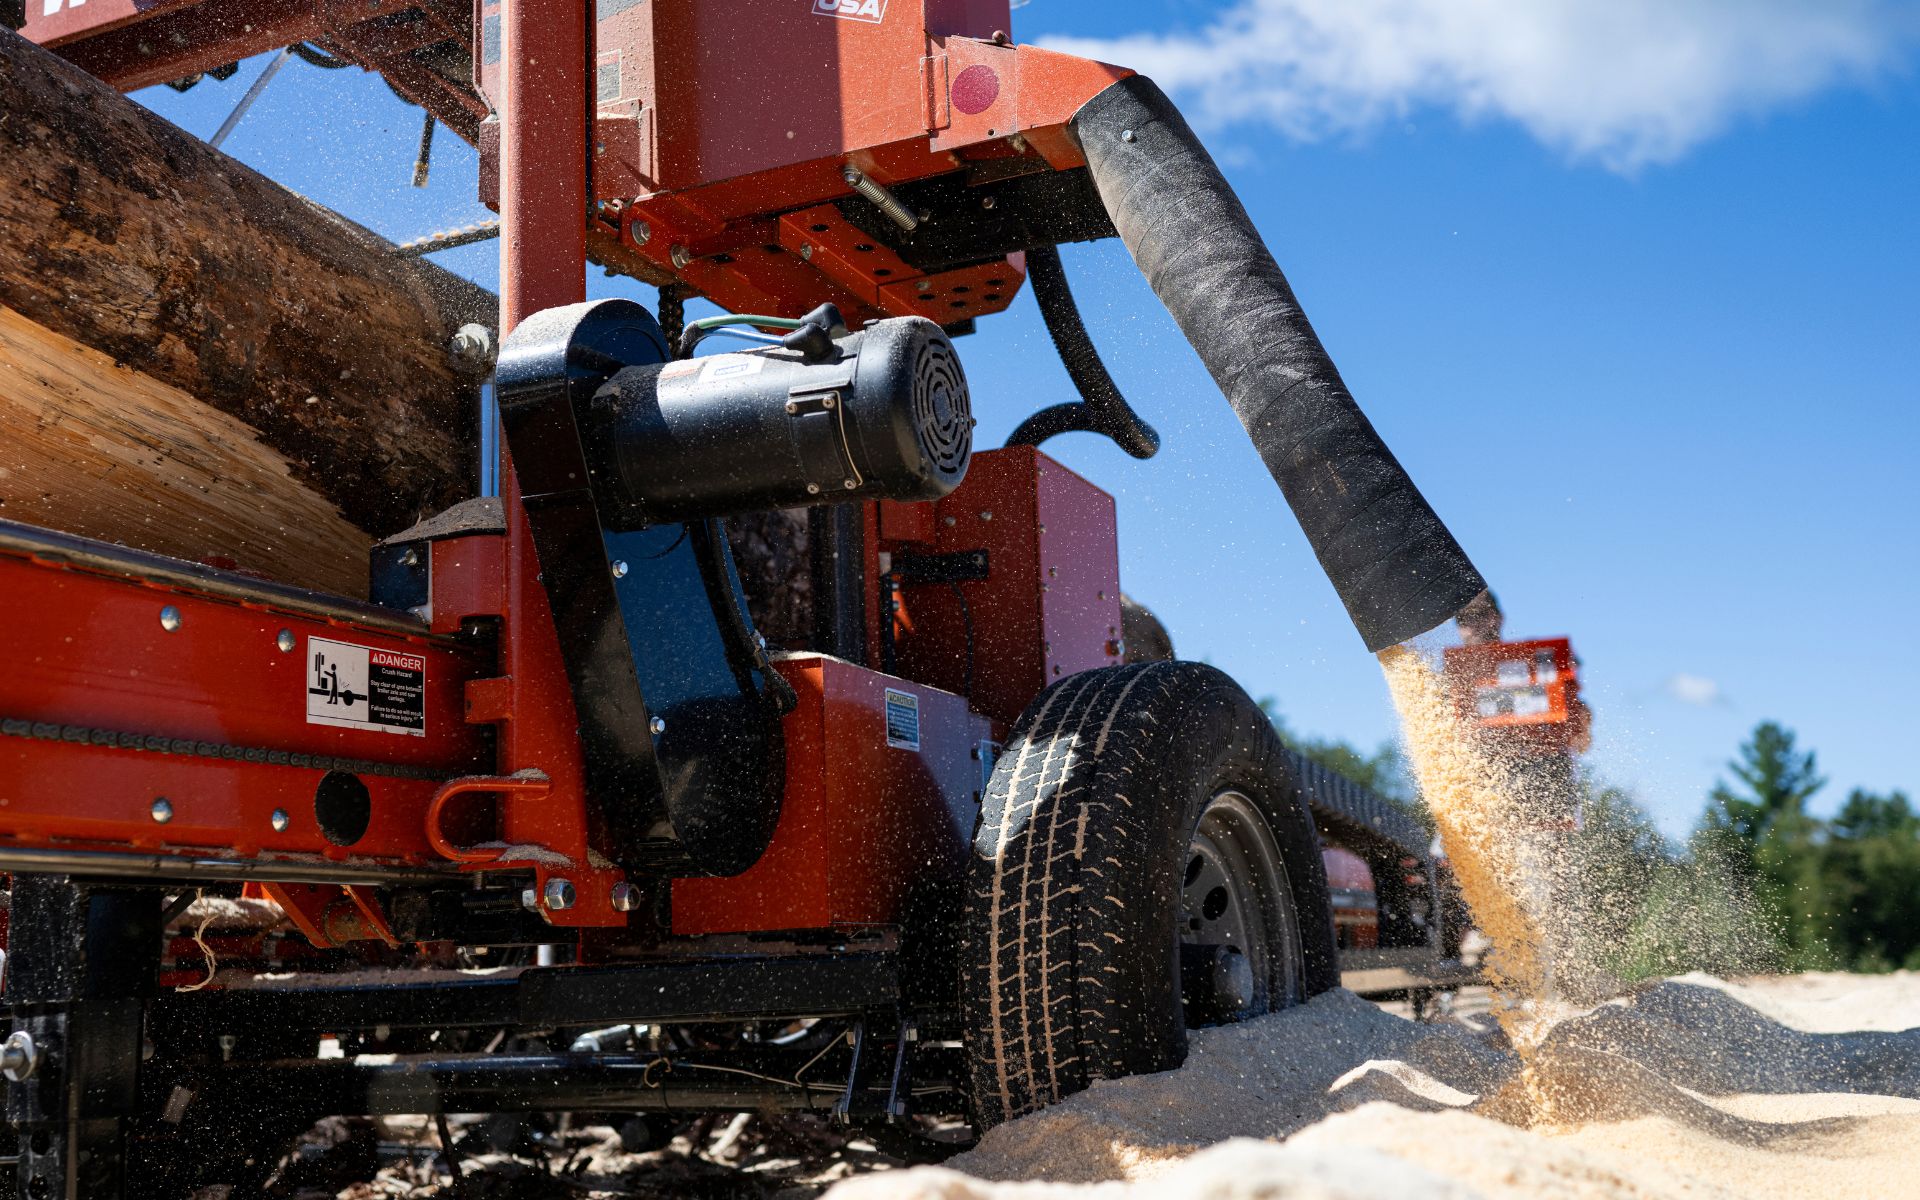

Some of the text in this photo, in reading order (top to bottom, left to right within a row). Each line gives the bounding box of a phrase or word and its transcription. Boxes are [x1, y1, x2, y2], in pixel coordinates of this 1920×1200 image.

[379, 653, 421, 670] DANGER
[381, 667, 413, 678] Crush Hazard
[370, 680, 380, 688] Stay
